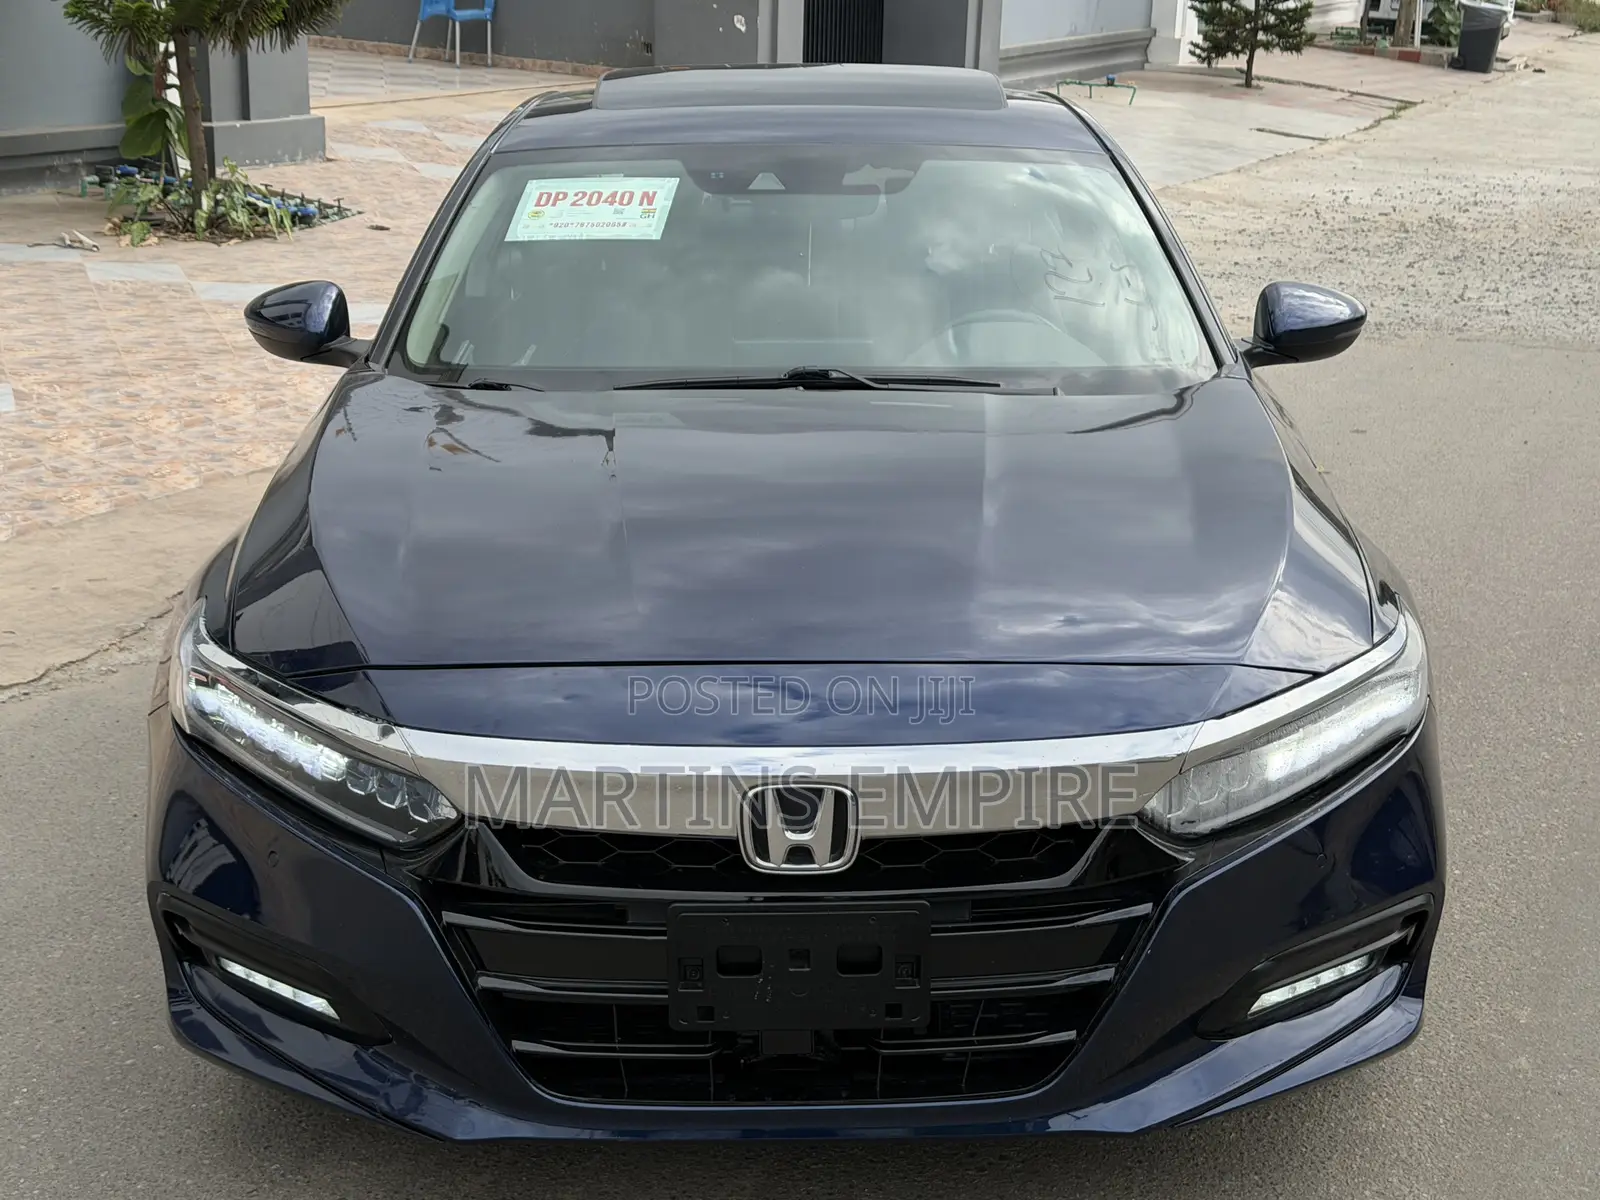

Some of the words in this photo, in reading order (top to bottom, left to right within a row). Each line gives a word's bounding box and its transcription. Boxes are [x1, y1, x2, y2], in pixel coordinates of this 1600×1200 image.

[534, 190, 569, 208] DP
[570, 190, 635, 207] 2040
[638, 191, 658, 207] N
